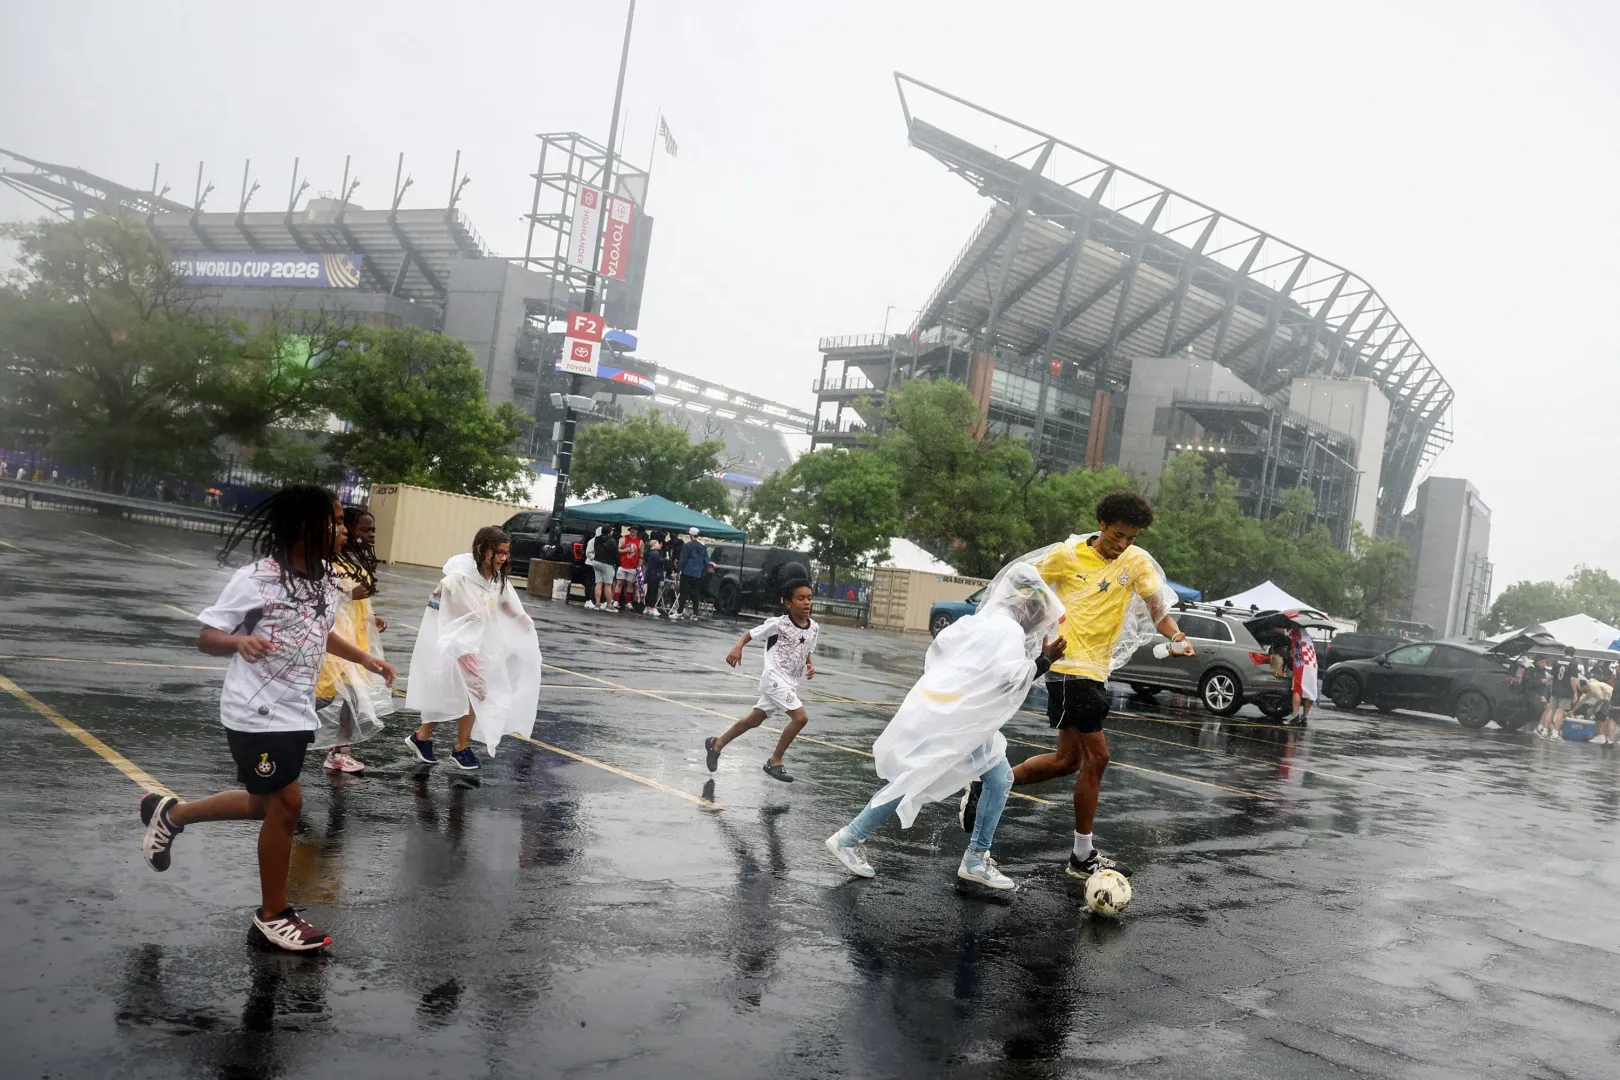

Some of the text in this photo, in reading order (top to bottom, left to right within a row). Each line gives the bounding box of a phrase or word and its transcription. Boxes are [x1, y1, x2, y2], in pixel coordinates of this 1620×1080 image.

[577, 210, 590, 265] HIGHLANDER
[607, 223, 624, 277] TOYOTA
[196, 261, 241, 277] WORLD
[243, 261, 270, 278] CUP
[271, 261, 320, 279] 2026
[574, 315, 597, 334] F2
[566, 363, 592, 373] TOYOTA
[623, 372, 638, 385] FIFA
[1557, 666, 1566, 680] 8
